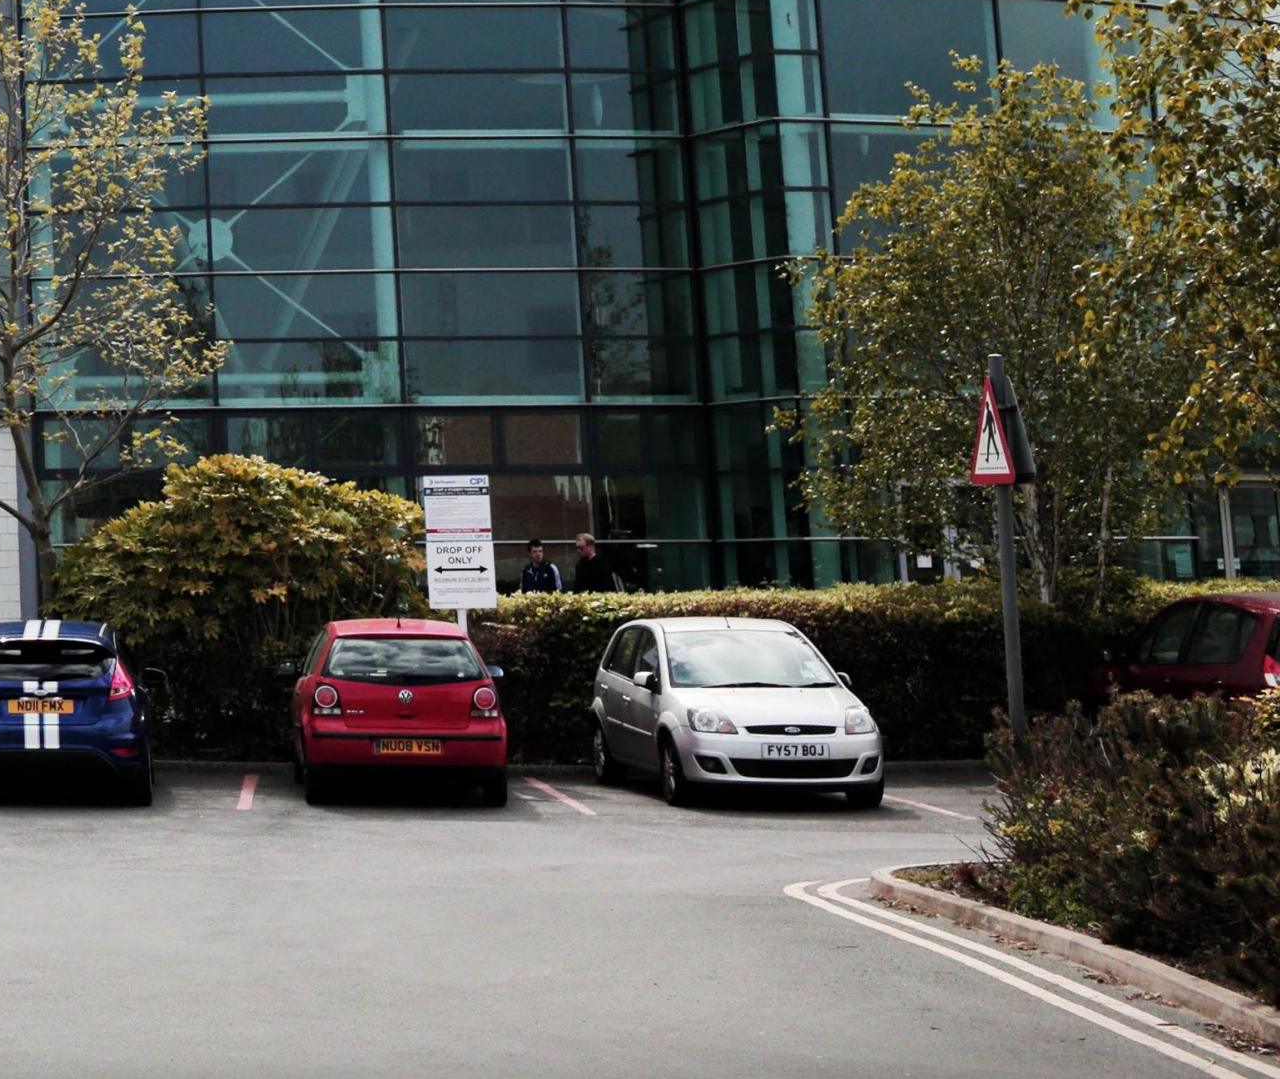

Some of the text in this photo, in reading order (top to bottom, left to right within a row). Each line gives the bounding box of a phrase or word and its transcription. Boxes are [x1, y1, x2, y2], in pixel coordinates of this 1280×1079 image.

[436, 546, 483, 554] DROP OFF
[448, 556, 472, 564] ONLY
[381, 739, 440, 752] NU08 VSN
[767, 745, 824, 756] FY57 BOJ
